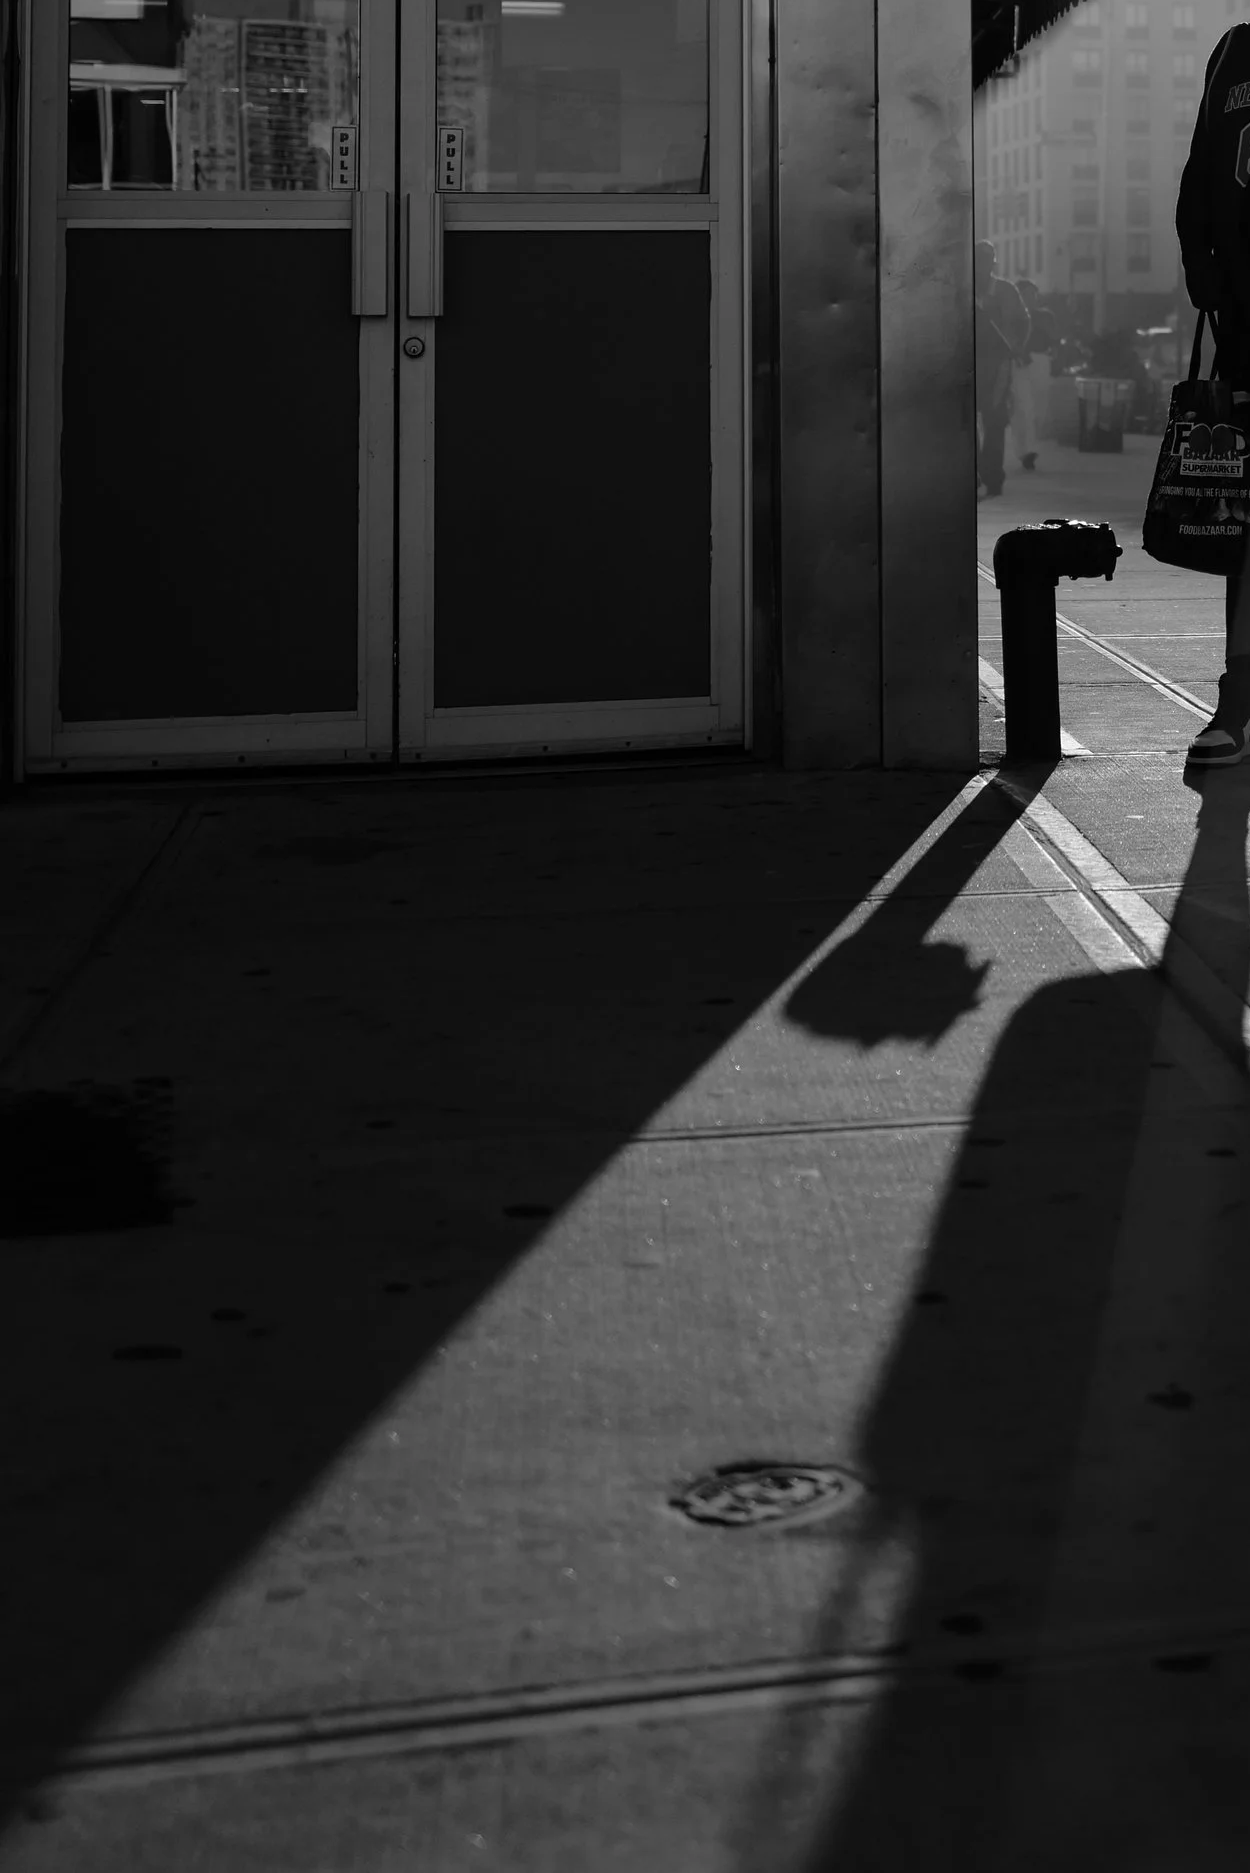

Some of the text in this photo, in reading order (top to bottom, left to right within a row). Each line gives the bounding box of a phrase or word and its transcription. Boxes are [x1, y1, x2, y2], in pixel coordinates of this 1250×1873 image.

[340, 132, 350, 184] PULL
[446, 133, 456, 185] PULL
[1171, 422, 1250, 457] FOOD
[1181, 463, 1242, 474] SUPERMARKET
[1184, 487, 1196, 497] YOU
[1203, 487, 1214, 498] THE
[1214, 487, 1239, 499] FLAVORS
[1239, 489, 1248, 500] OF
[1178, 524, 1243, 536] FOODBAZAAR.COM
